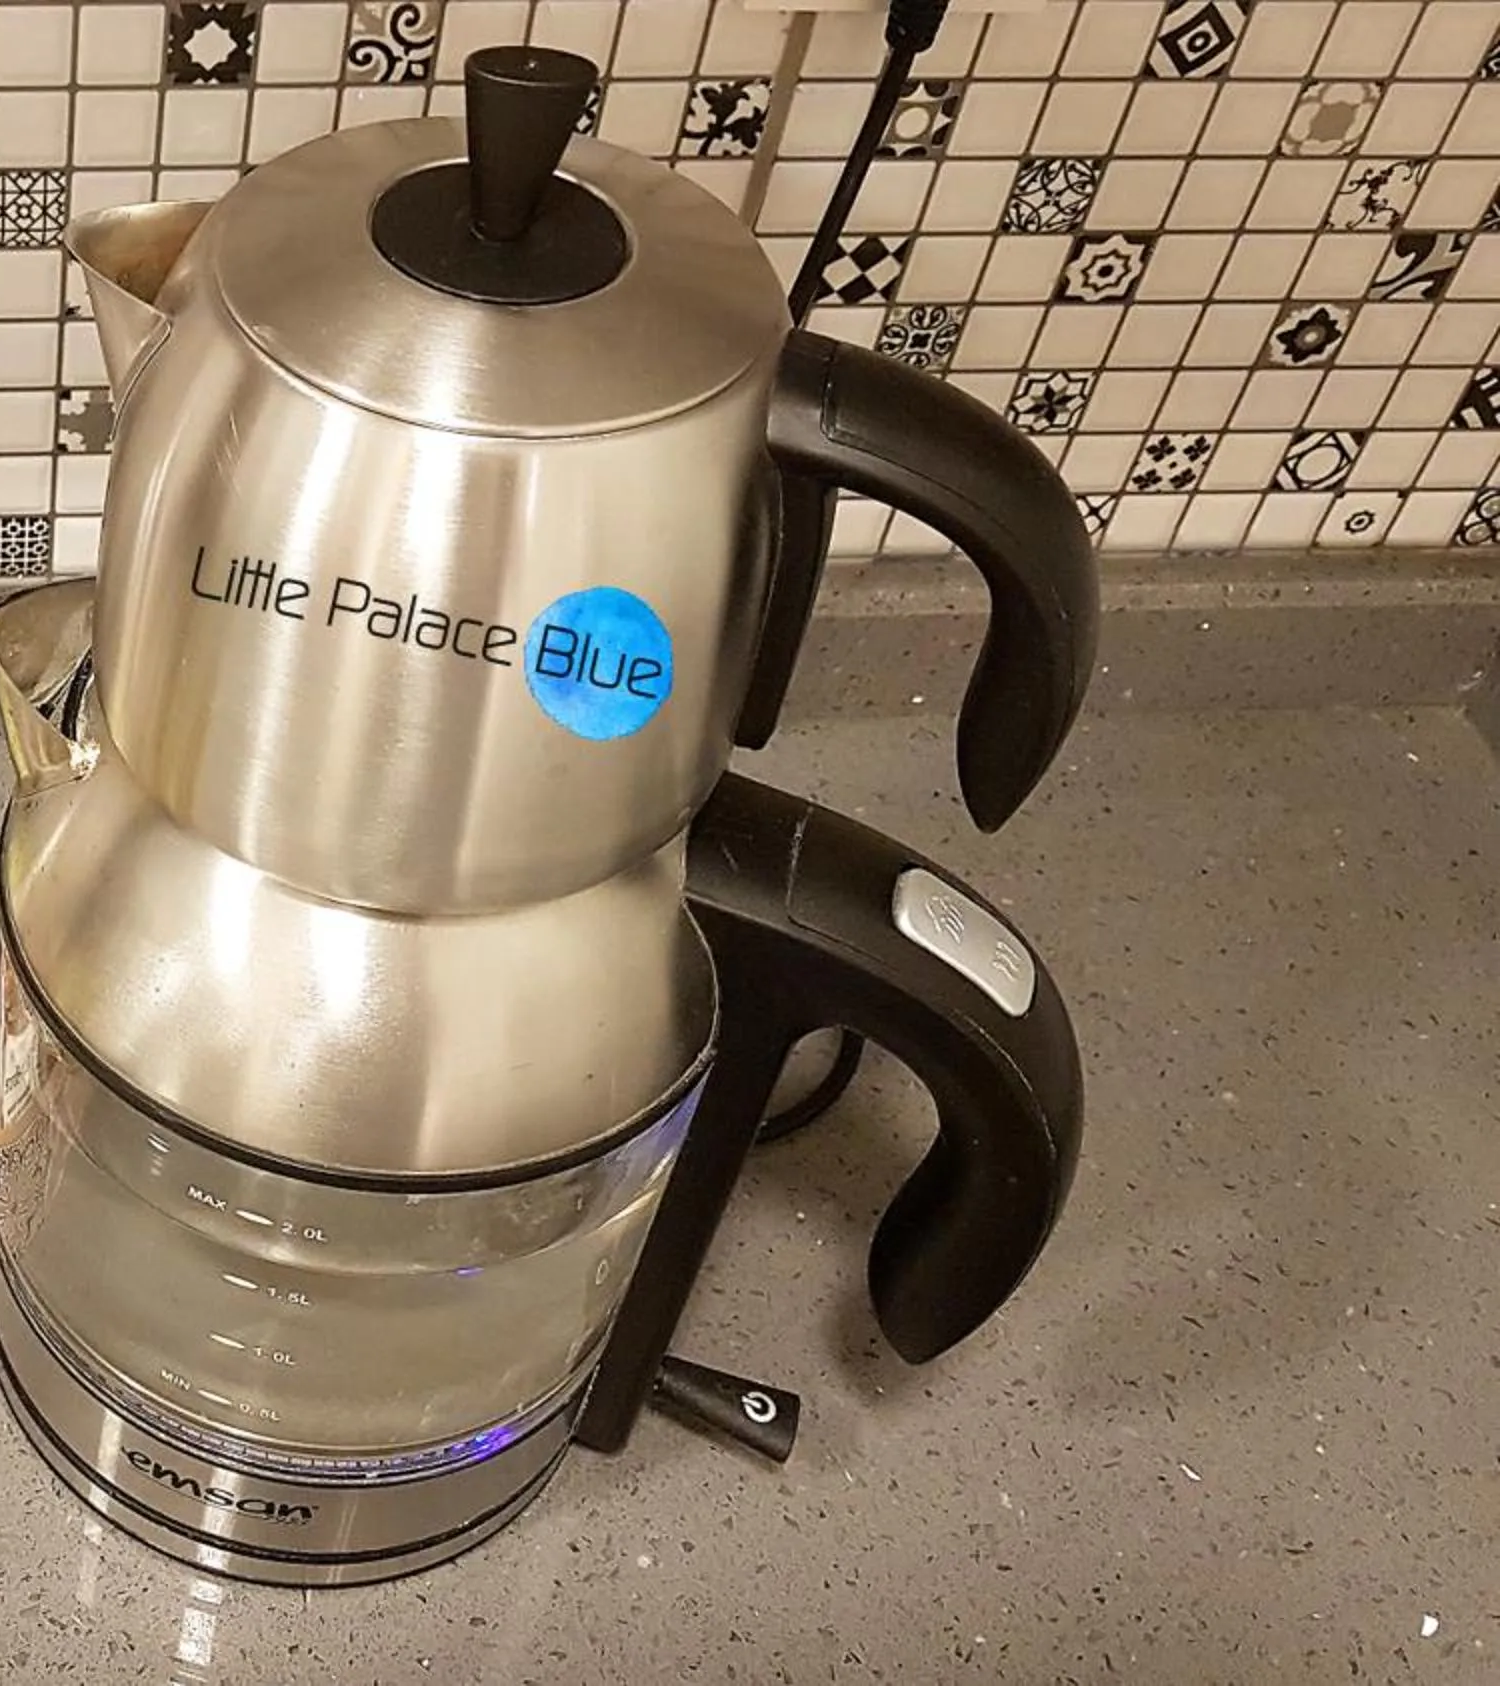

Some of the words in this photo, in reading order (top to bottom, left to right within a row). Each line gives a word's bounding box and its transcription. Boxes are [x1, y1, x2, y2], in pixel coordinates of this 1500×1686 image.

[191, 546, 310, 620] Little
[327, 576, 517, 667] Palace
[535, 623, 662, 700] Blue
[187, 1186, 228, 1212] MAX
[160, 1368, 192, 1391] MIN
[122, 1445, 313, 1520] emsan
